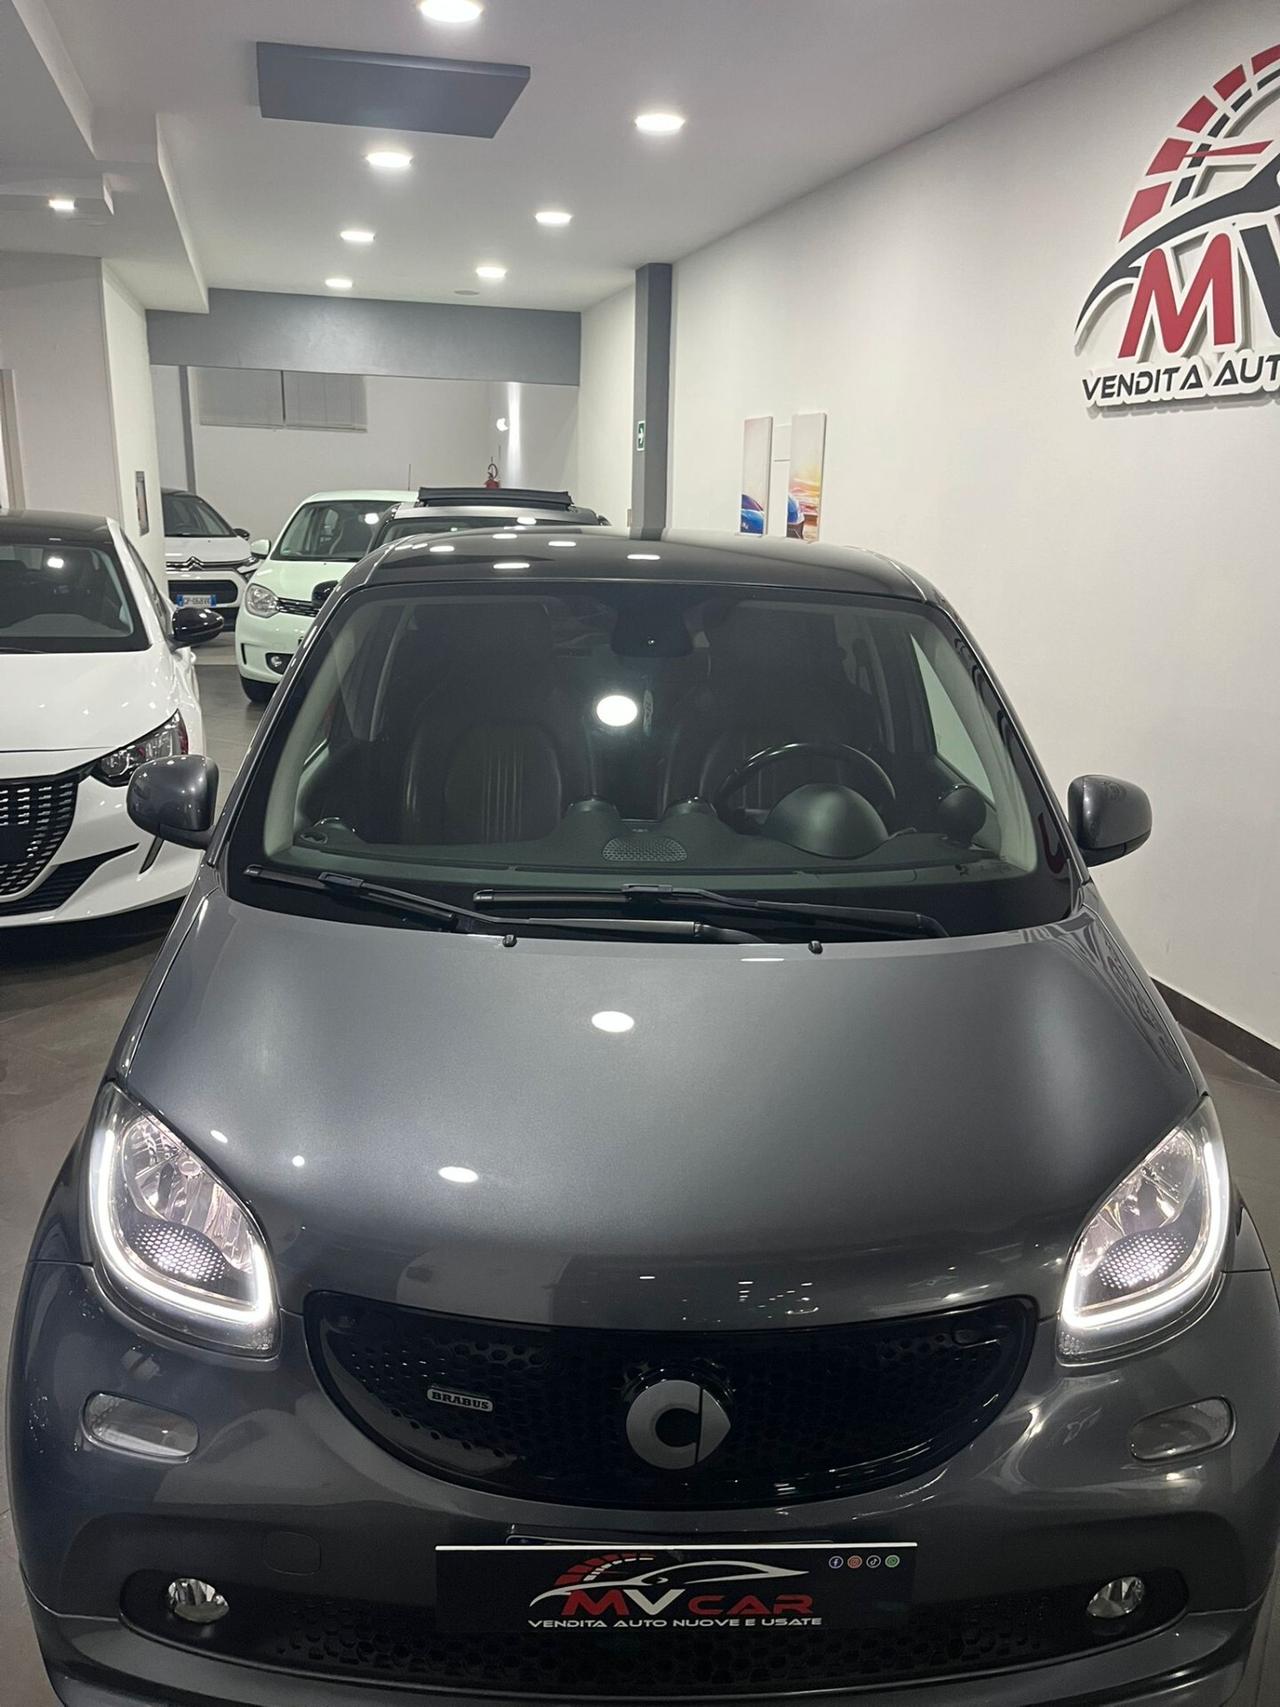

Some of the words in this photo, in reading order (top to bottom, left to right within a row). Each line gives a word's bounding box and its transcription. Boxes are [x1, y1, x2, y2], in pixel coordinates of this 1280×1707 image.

[1082, 364, 1204, 401] VENDITA
[431, 1391, 490, 1410] BRABUS
[527, 1619, 608, 1628] VENDITA
[613, 1619, 668, 1628] AUTO
[672, 1618, 741, 1627] NUOVE
[744, 1618, 757, 1627] E
[761, 1617, 823, 1626] USATE
